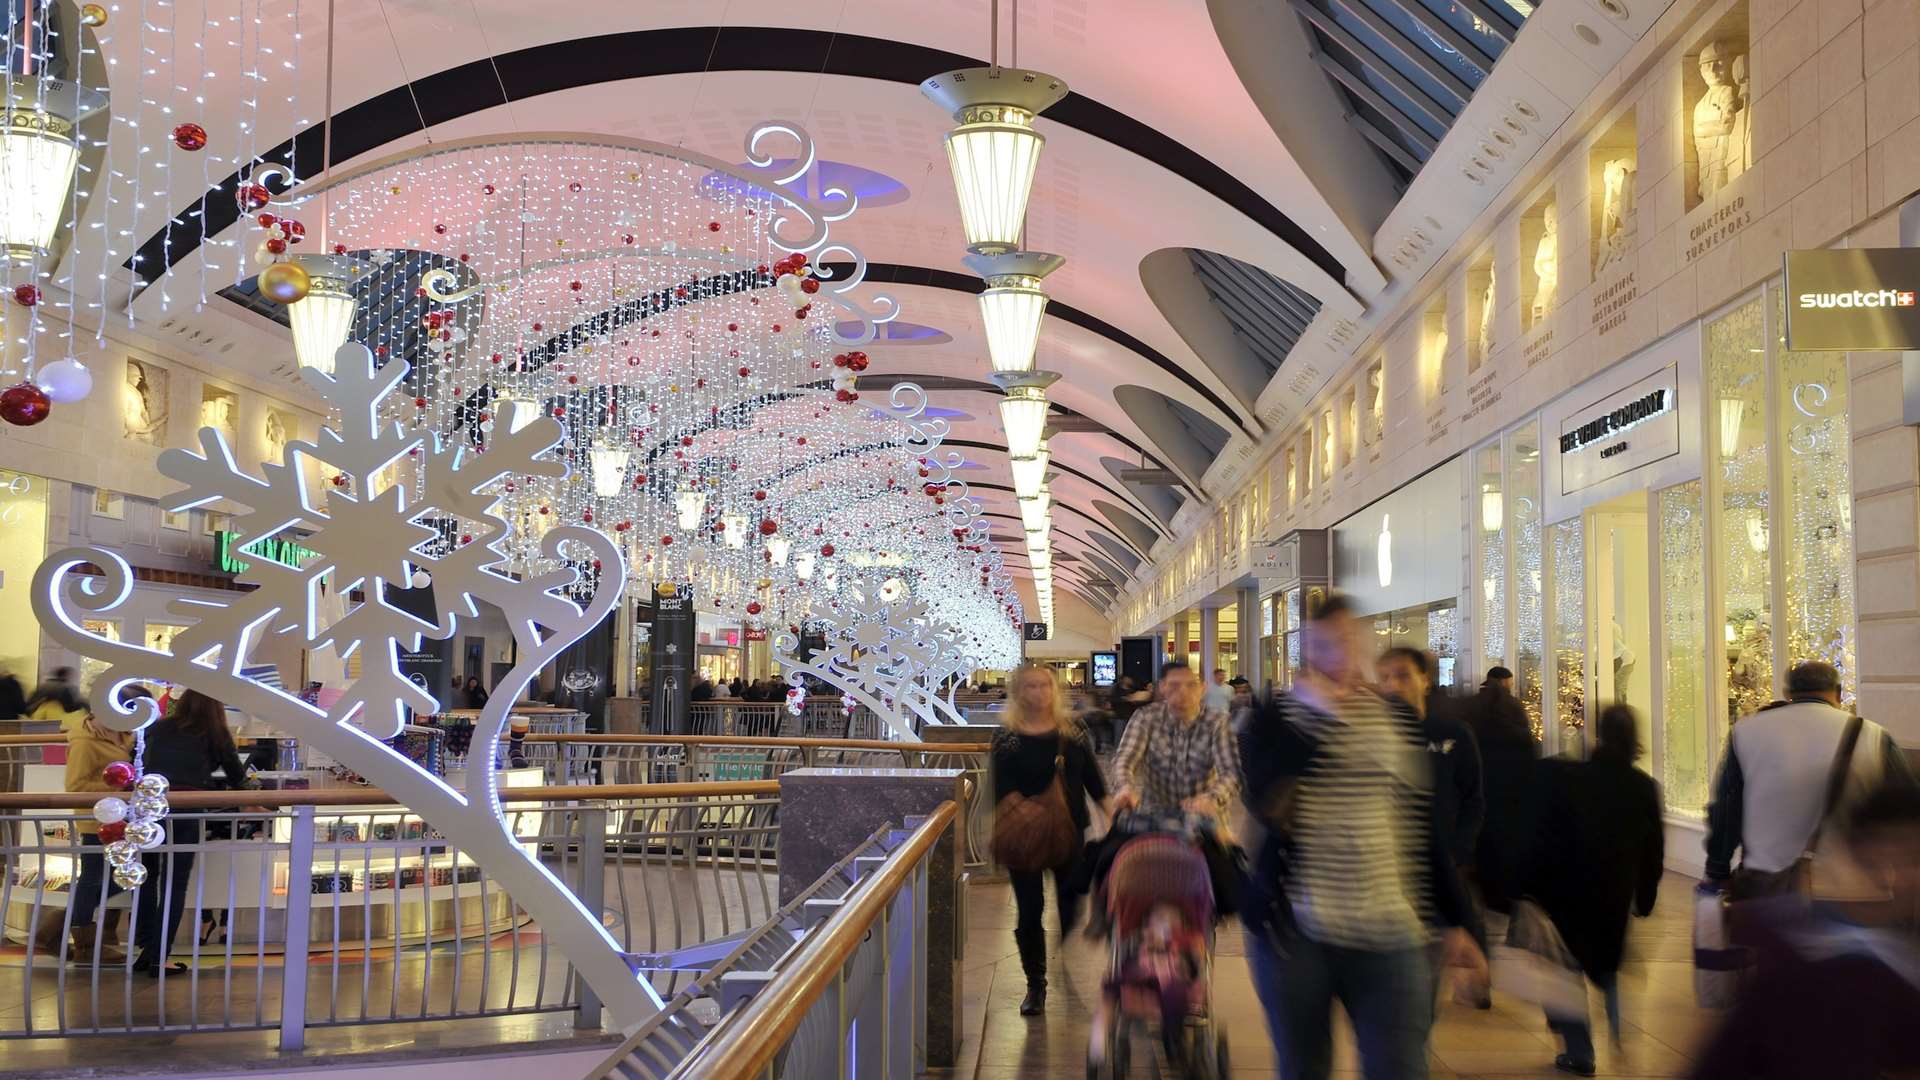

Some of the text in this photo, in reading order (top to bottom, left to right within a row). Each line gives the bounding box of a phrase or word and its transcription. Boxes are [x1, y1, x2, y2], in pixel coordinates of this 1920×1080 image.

[1686, 210, 1751, 262] SURVEYORS
[1690, 196, 1744, 240] CHARTERED
[1800, 289, 1897, 308] swatch
[1559, 430, 1578, 454] THE
[1609, 389, 1667, 431] COMPANY
